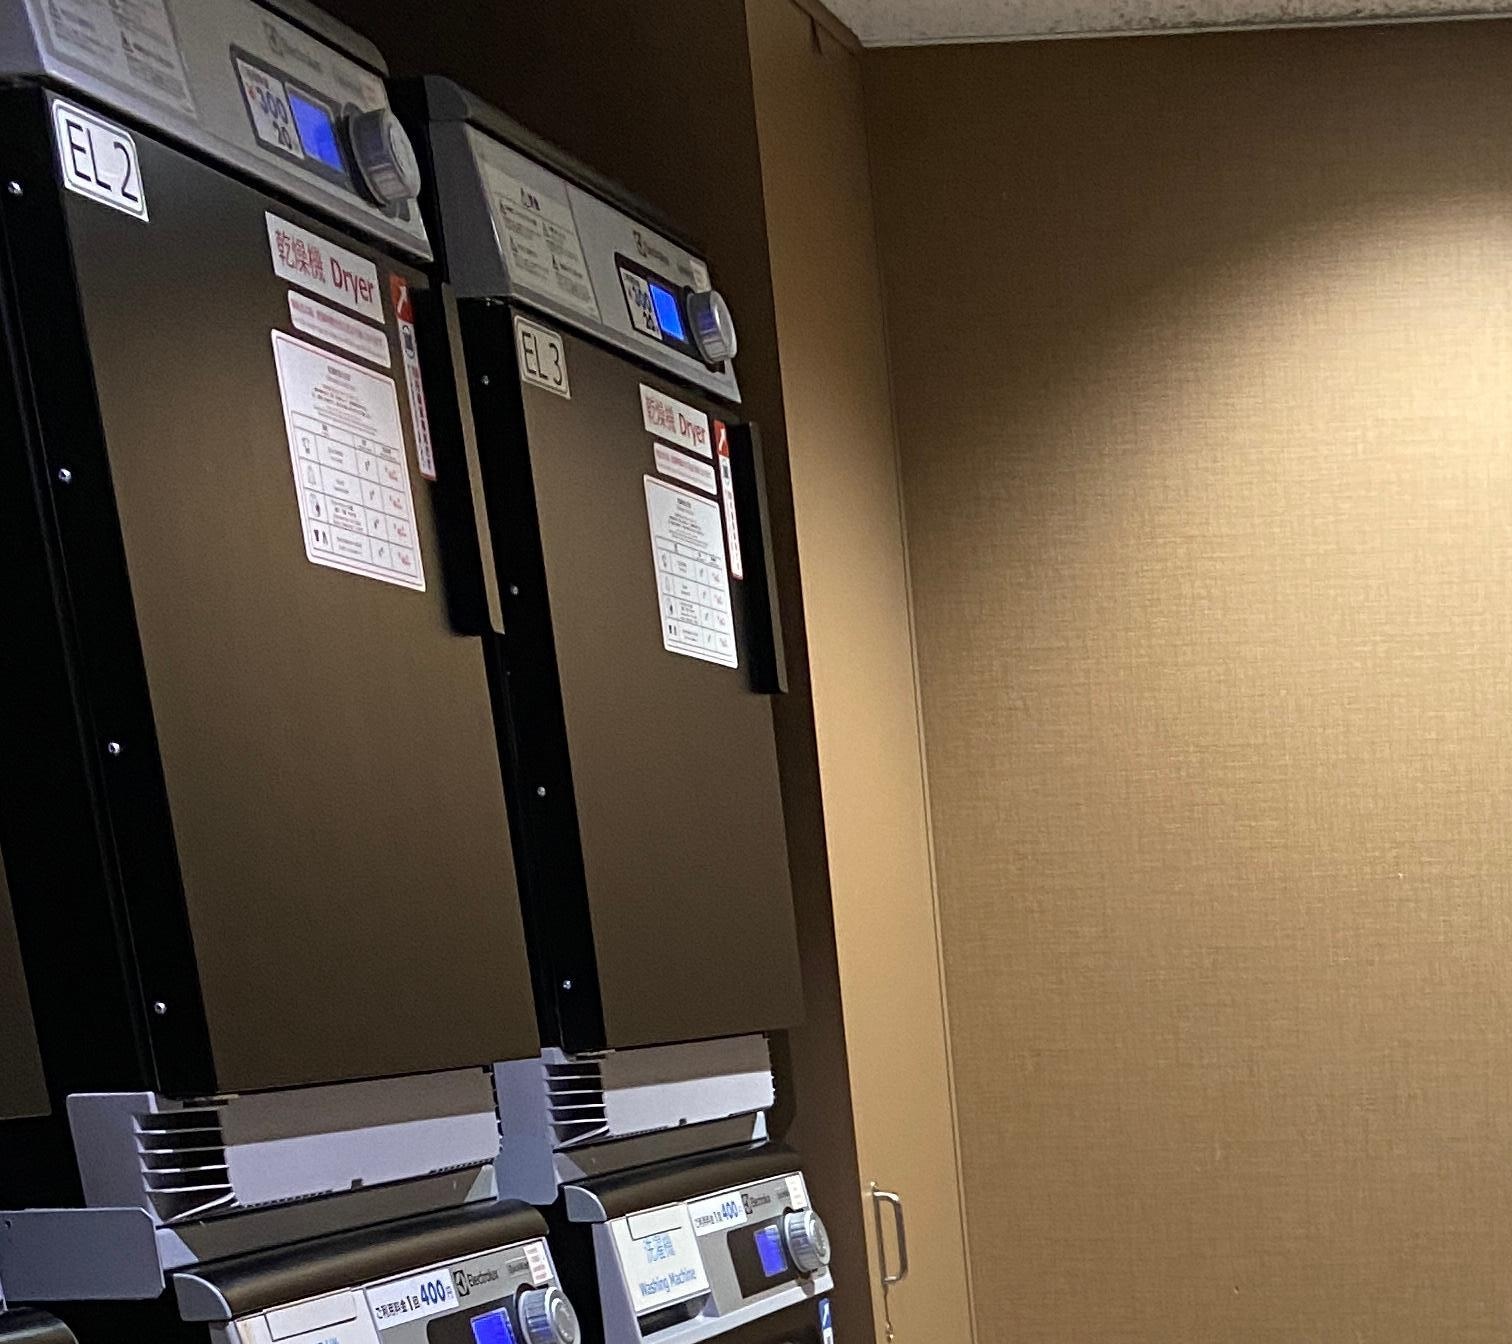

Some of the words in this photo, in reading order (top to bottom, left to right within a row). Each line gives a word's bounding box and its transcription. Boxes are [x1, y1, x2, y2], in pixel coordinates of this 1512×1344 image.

[275, 230, 326, 283] 乾燥機
[330, 256, 374, 304] Dryer
[521, 331, 563, 386] EL3
